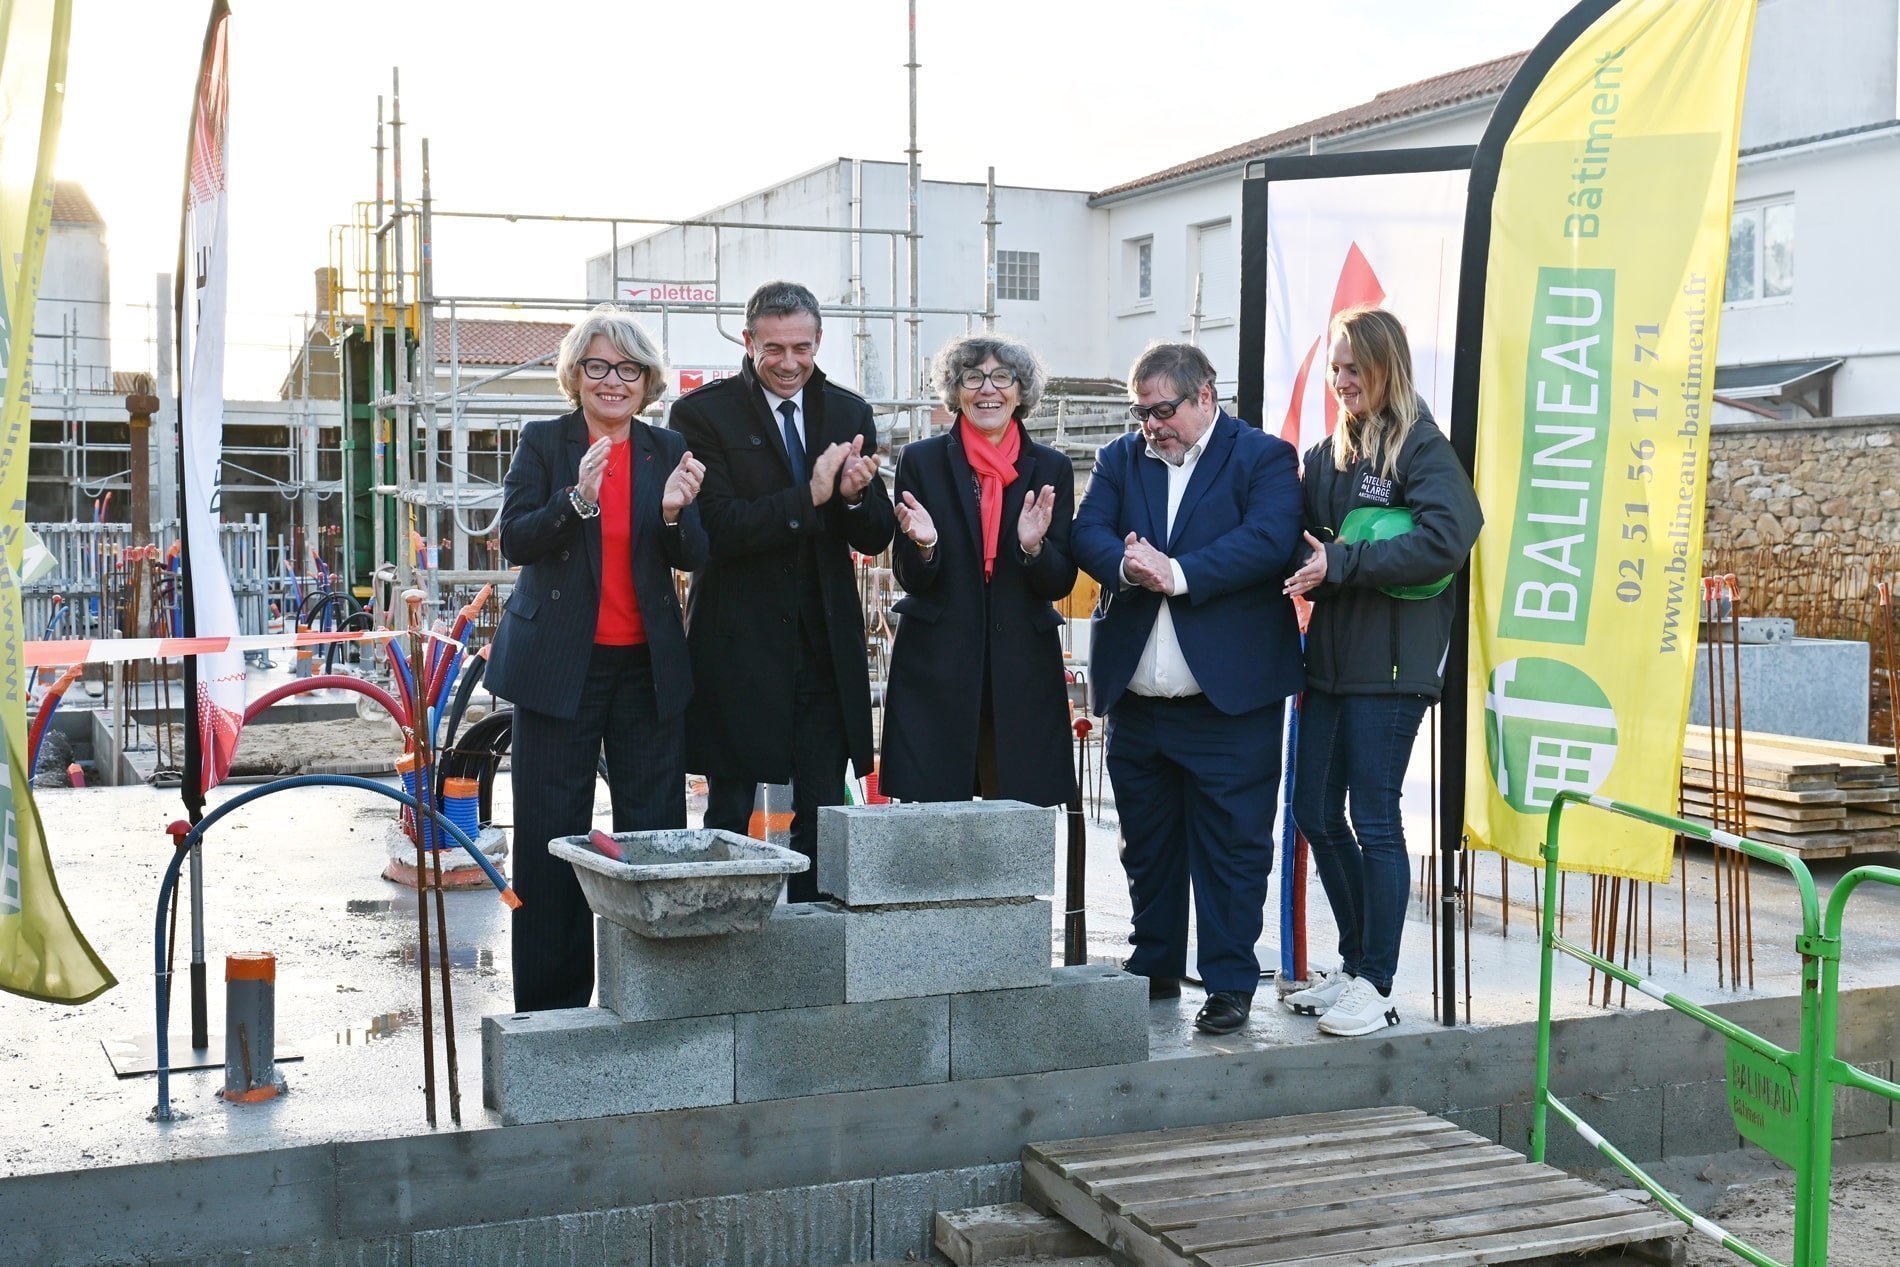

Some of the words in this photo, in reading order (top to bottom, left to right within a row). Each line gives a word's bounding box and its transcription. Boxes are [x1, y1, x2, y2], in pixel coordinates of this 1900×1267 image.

[1563, 46, 1626, 238] Bâtiment
[650, 284, 715, 302] plettac
[1633, 322, 1660, 362] 71
[1632, 379, 1659, 422] 17
[1513, 286, 1603, 622] BALINEAU
[1627, 439, 1656, 484] 56
[1659, 272, 1707, 654] www.balineau-batiment.fr
[1366, 484, 1391, 498] LARGE
[1621, 503, 1650, 543] 51
[1615, 558, 1645, 603] 02
